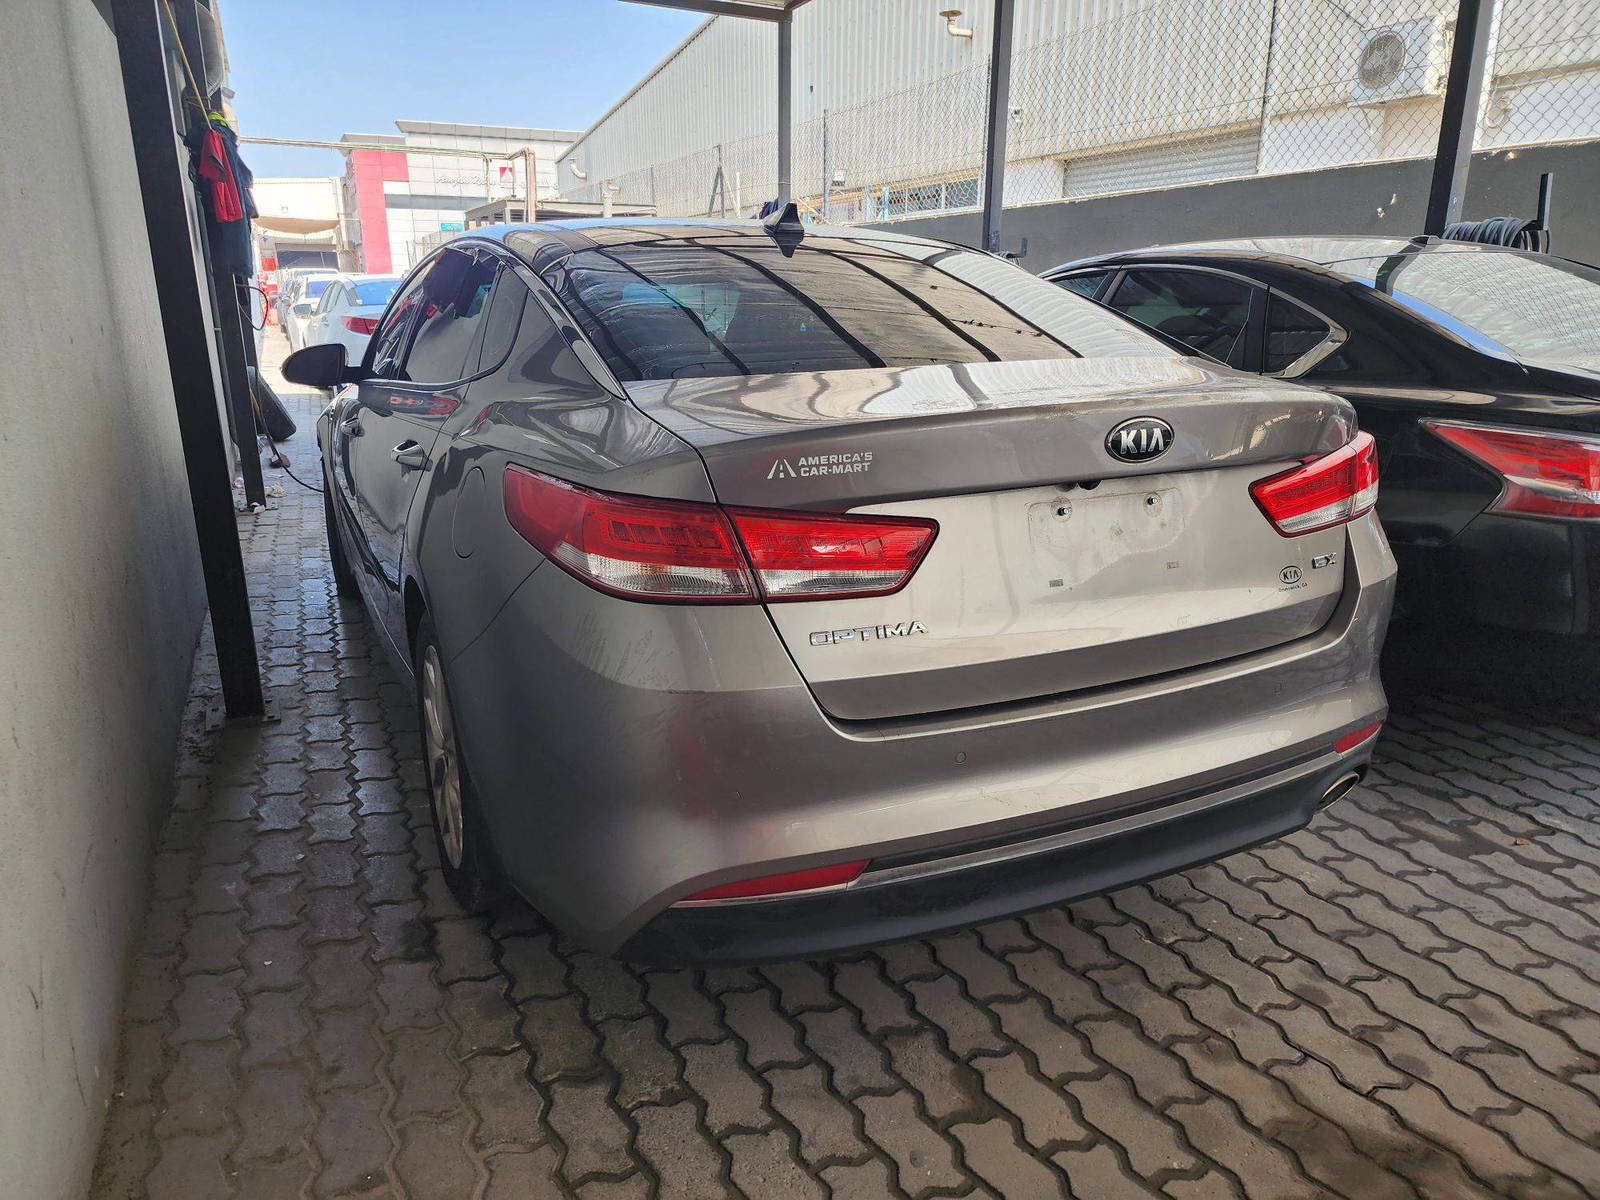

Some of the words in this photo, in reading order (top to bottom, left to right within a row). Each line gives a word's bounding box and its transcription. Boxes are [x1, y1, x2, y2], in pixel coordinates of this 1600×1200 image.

[1120, 427, 1165, 455] KIA
[798, 451, 873, 467] AMERICA'S
[800, 462, 871, 477] CAR-MART
[1312, 552, 1337, 569] EX
[1282, 569, 1299, 581] KIA
[809, 620, 929, 646] OPTIMA
